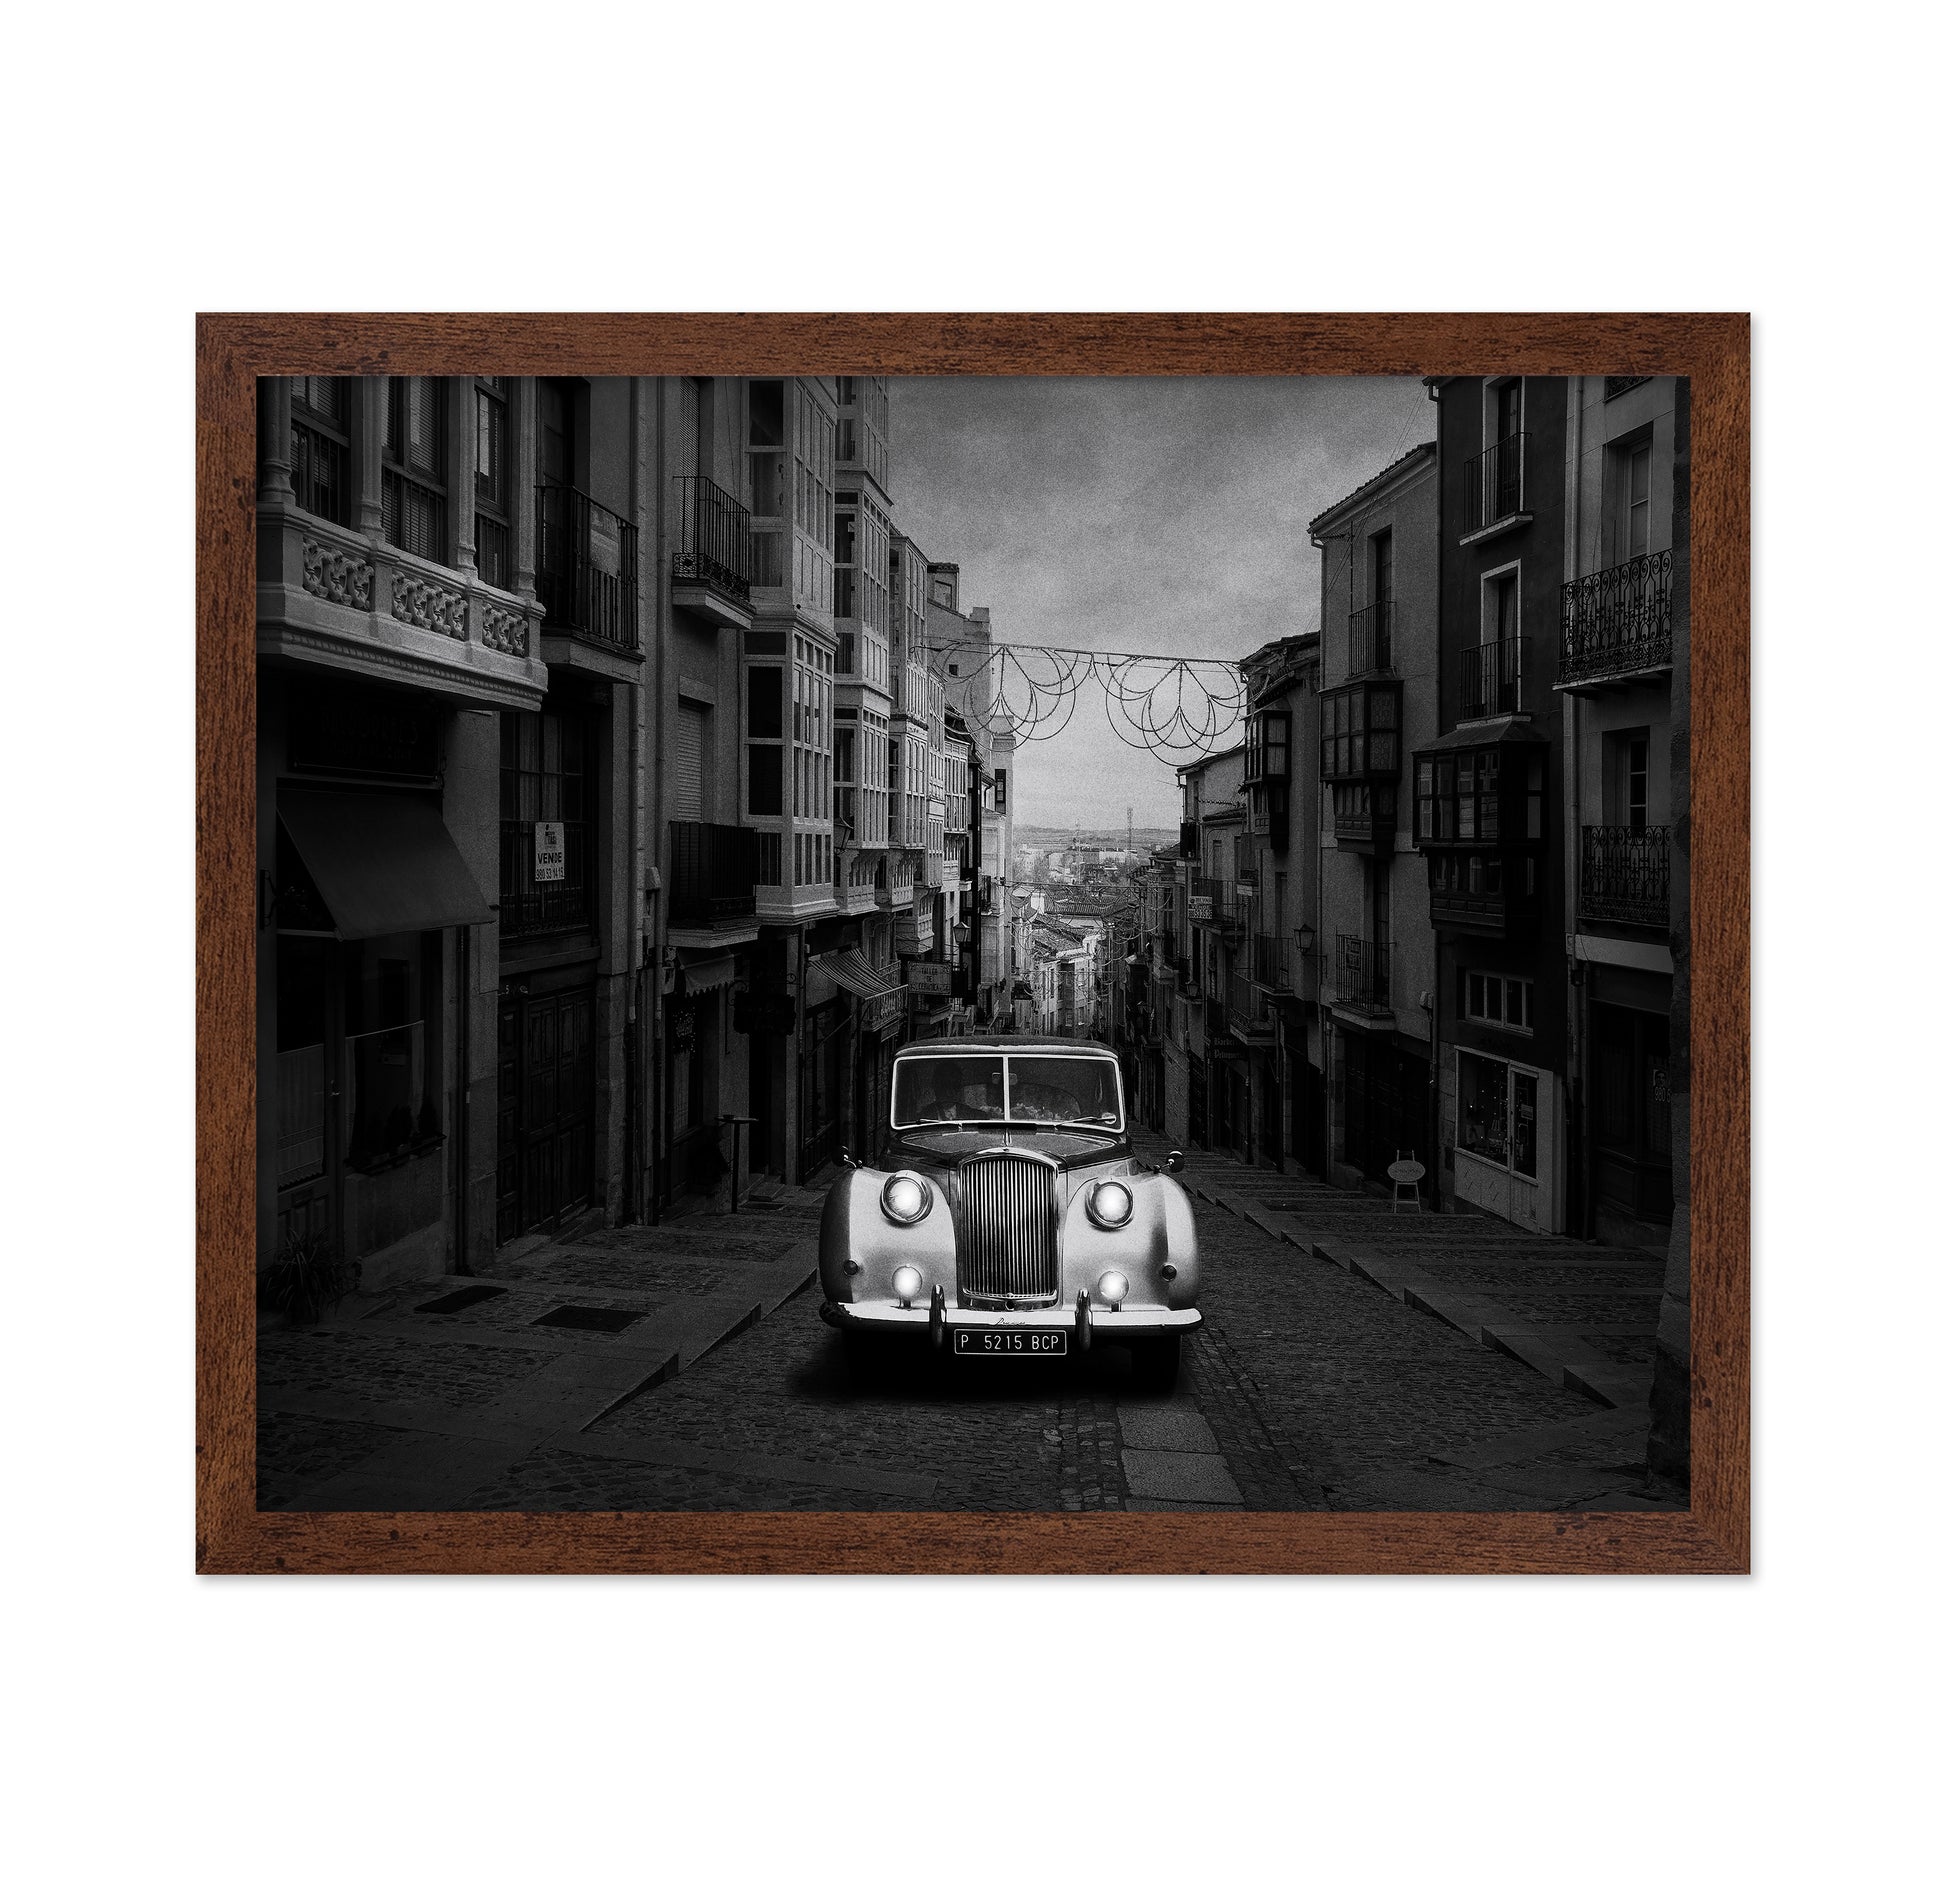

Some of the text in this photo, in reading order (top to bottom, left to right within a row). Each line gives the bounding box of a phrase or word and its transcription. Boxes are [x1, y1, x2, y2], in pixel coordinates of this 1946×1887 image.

[537, 852, 562, 864] VENDE
[961, 1334, 1059, 1350] P 5215 BCP
